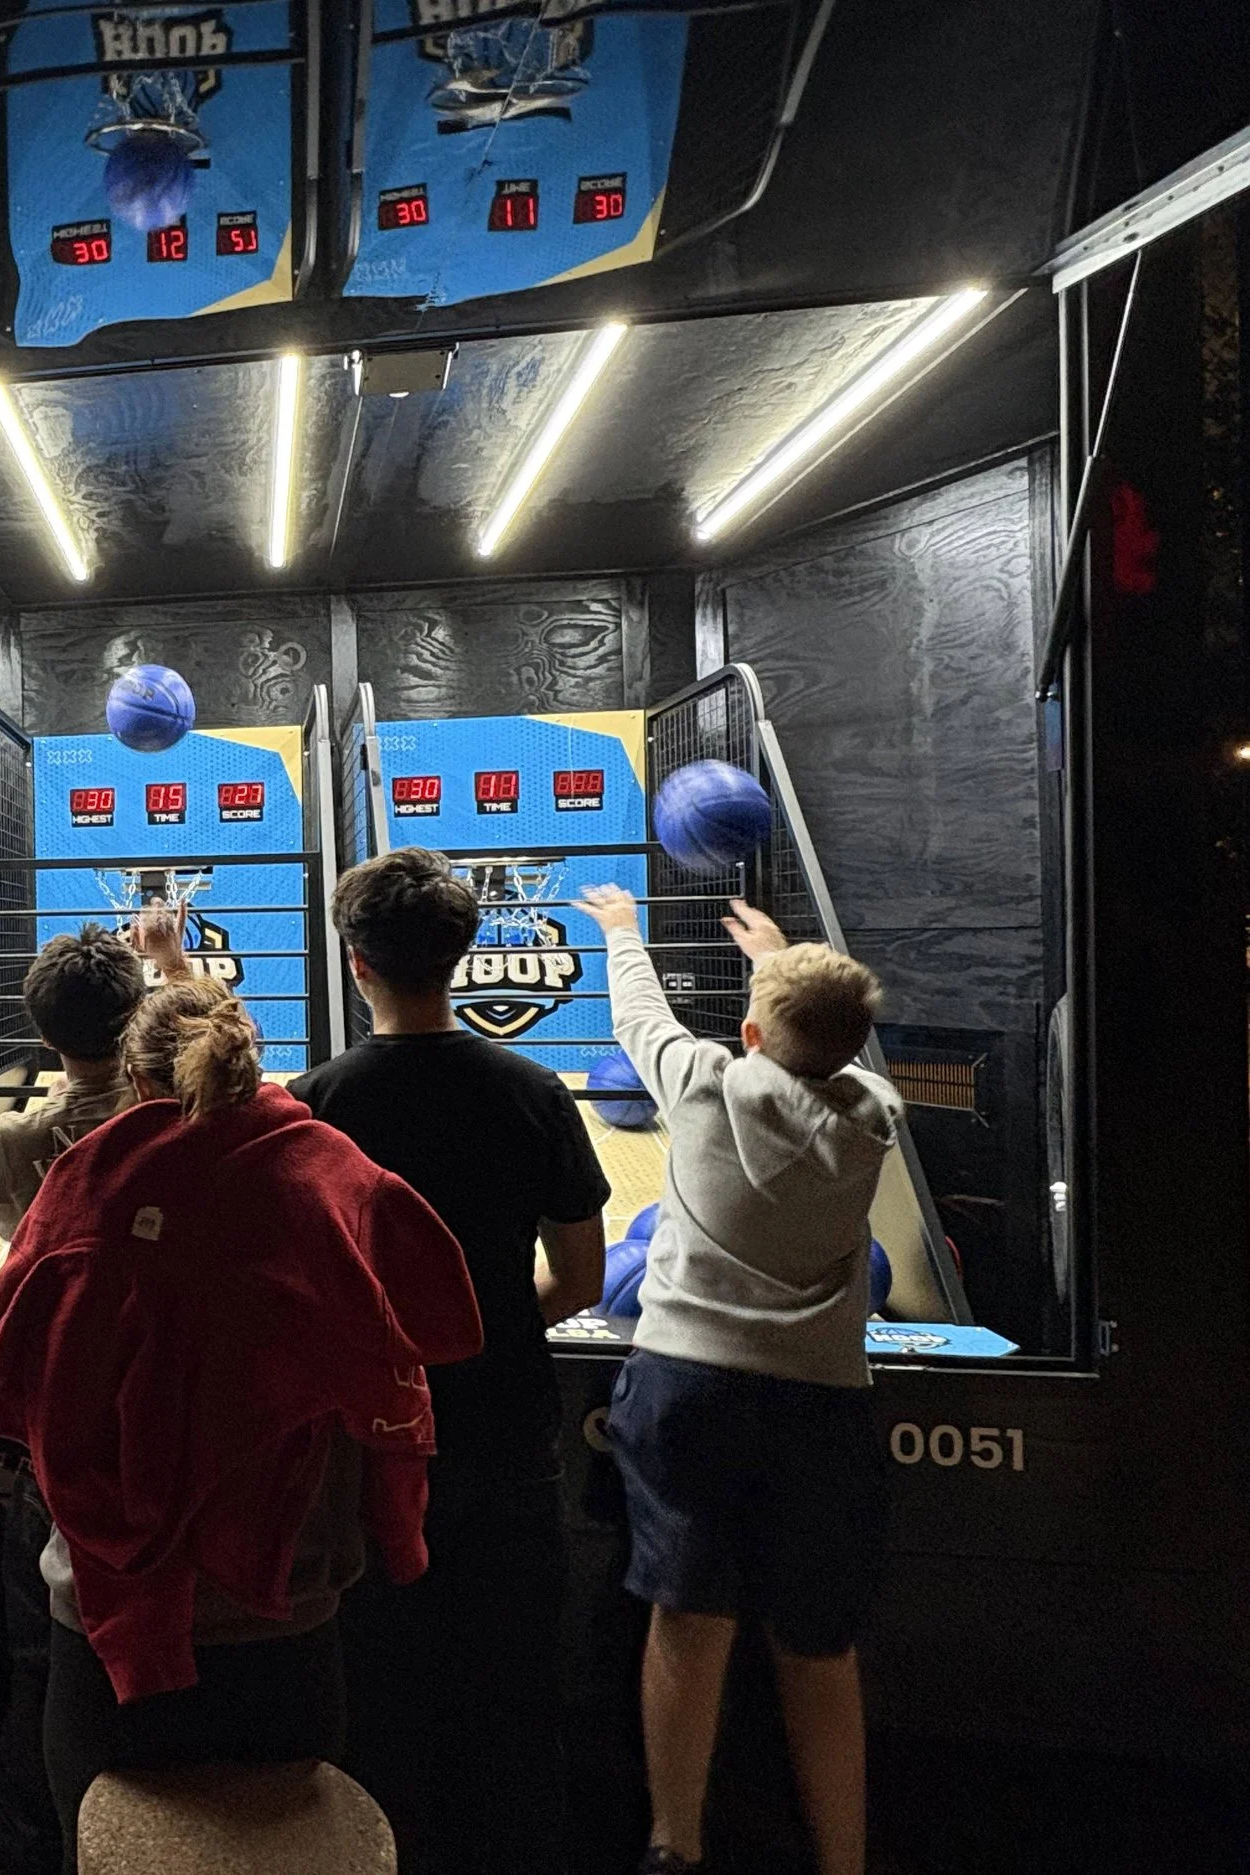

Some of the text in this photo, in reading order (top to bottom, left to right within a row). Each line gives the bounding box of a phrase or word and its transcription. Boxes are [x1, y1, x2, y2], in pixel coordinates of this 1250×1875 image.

[235, 784, 262, 805] 27
[411, 779, 439, 799] 30
[87, 789, 113, 810] 30
[158, 785, 183, 809] 15
[395, 803, 438, 814] HIGHEST
[483, 802, 512, 812] TIME
[557, 798, 601, 808] SCORE
[72, 813, 113, 824] HIGHEST
[153, 813, 180, 823] TIME
[222, 809, 261, 819] SCORE
[889, 1422, 1025, 1471] 0051
